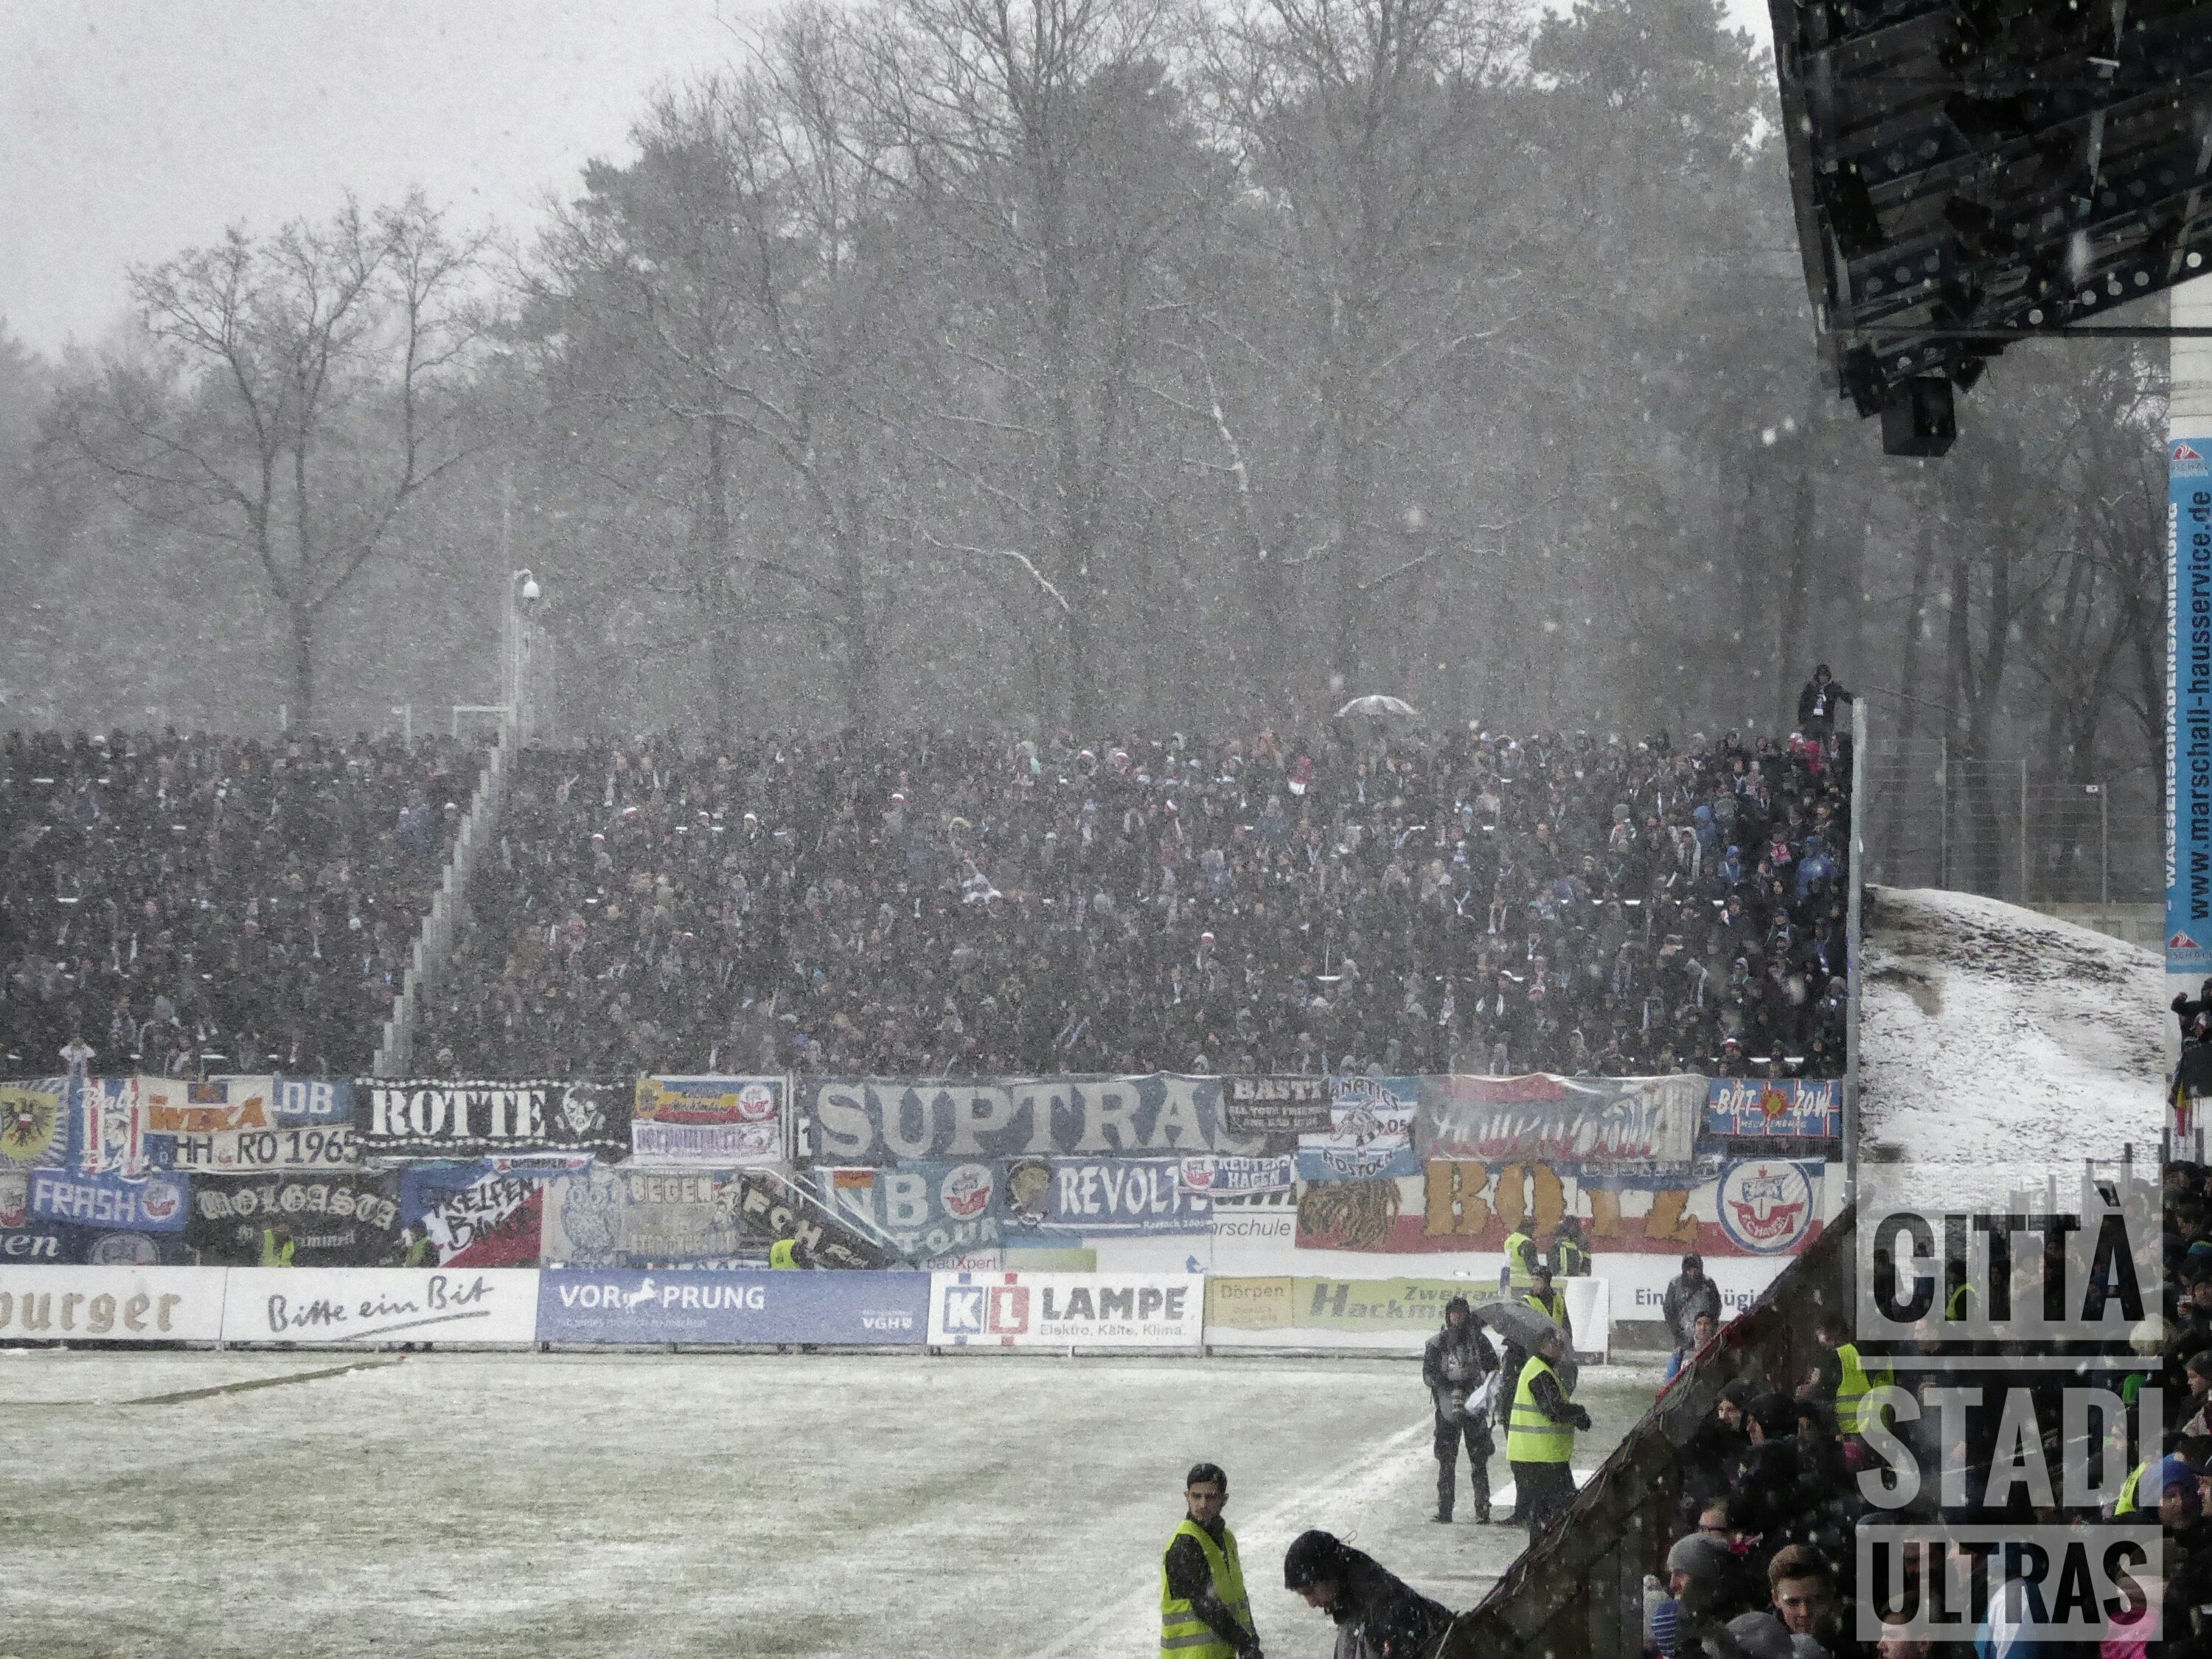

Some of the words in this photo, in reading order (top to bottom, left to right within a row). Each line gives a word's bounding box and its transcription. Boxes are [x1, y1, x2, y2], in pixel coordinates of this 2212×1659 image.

[2166, 502, 2177, 889] WASSERSCHADENSANIERUNG
[2187, 490, 2211, 921] www.marschall-hausservice.de
[370, 1089, 546, 1137] ROTTE
[817, 1078, 1268, 1158] SUPTRA
[237, 1132, 276, 1164] RO
[285, 1130, 360, 1164] 1965
[1228, 1171, 1280, 1189] HAGEN
[0, 1234, 59, 1256] en
[268, 1295, 347, 1332] Bitte
[359, 1294, 419, 1318] ein
[428, 1276, 494, 1310] Bit
[1041, 1286, 1189, 1321] LAMPE
[1221, 1284, 1284, 1300] Dörpen
[1635, 1289, 1665, 1305] Ein
